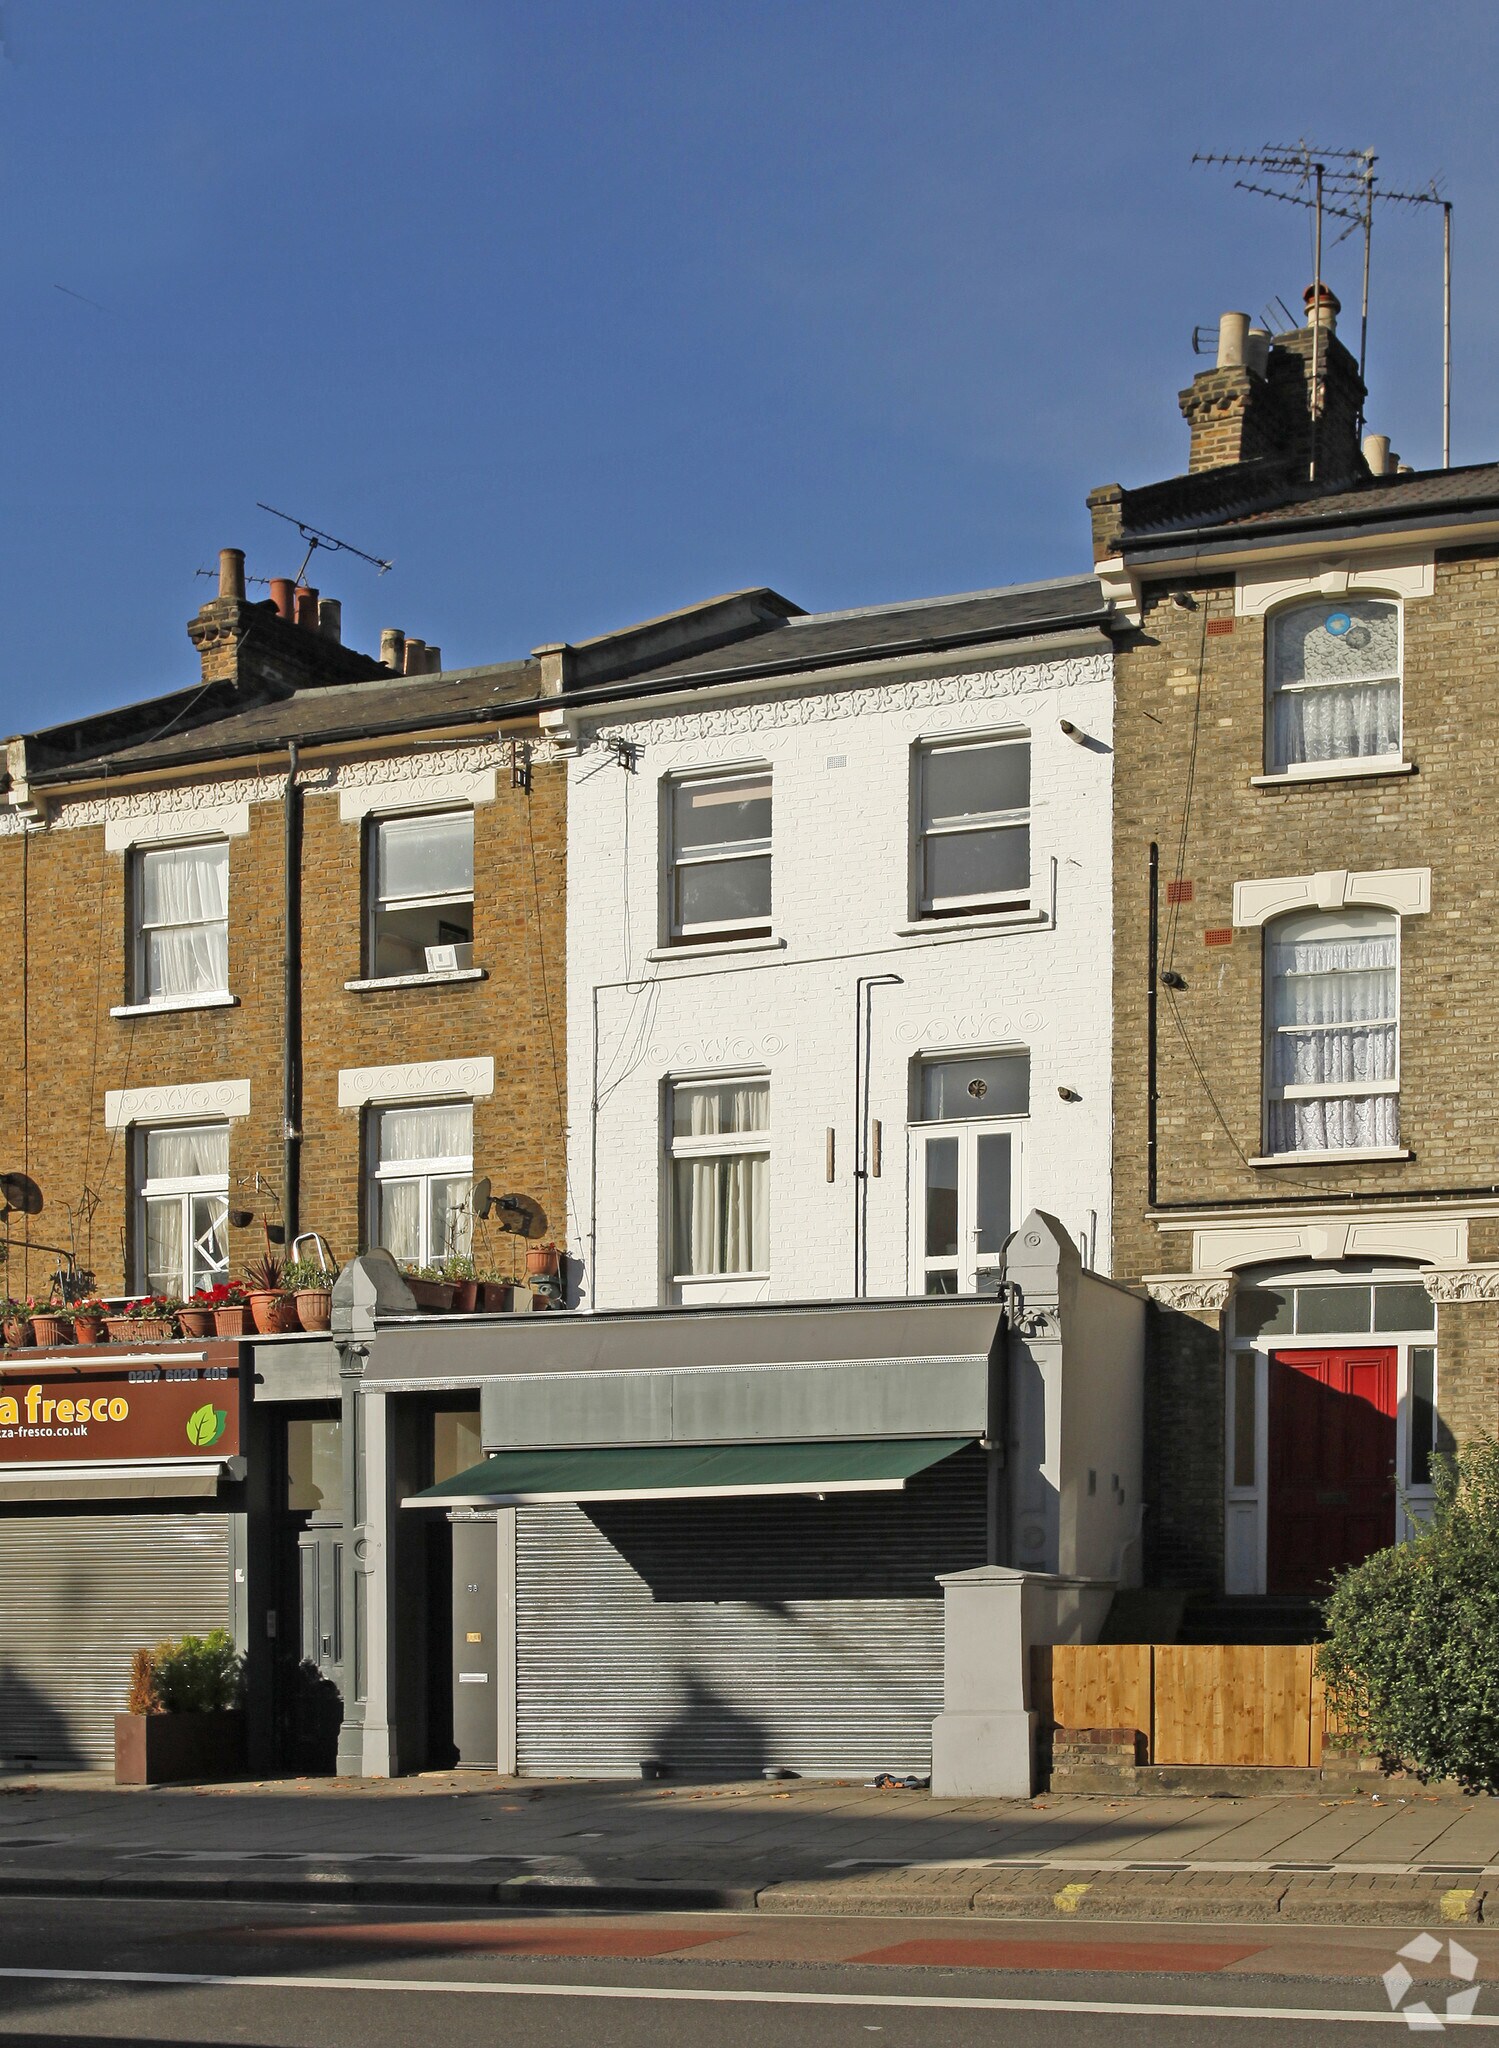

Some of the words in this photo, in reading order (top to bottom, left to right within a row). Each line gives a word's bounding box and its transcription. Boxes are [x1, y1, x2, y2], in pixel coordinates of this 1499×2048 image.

[128, 1370, 160, 1384] 0207
[165, 1369, 199, 1383] 6020
[203, 1367, 228, 1380] 405
[24, 1384, 129, 1424] fresco
[0, 1424, 88, 1438] za-fresco.co.uk
